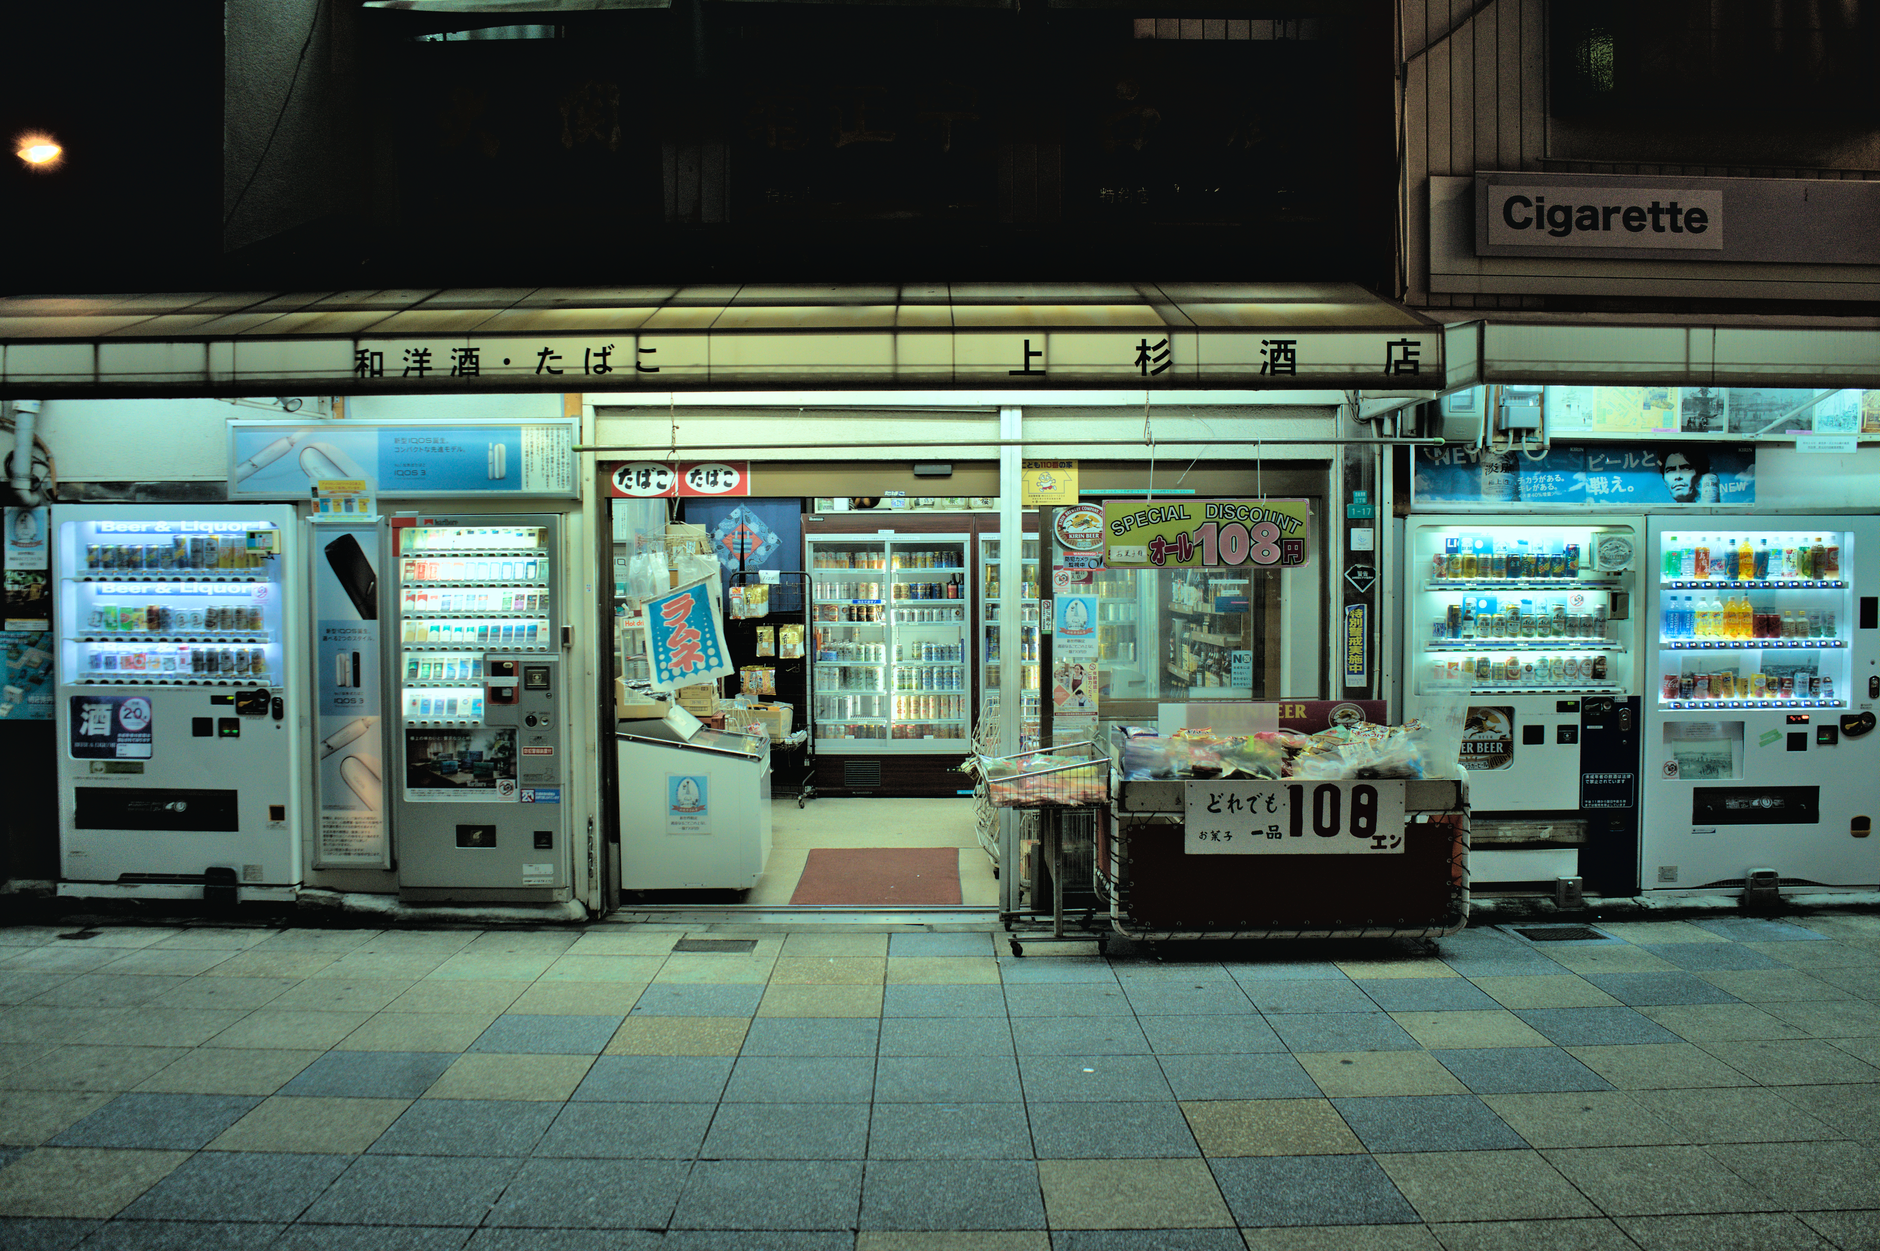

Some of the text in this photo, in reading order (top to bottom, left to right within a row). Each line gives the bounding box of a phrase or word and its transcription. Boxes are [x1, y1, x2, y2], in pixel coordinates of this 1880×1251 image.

[1503, 195, 1708, 237] Cigarette
[354, 343, 660, 378] 和洋酒・たばこ
[1008, 337, 1421, 377] 上杉酒店
[1433, 447, 1486, 466] NEW
[1588, 450, 1663, 472] ビールと、
[617, 467, 668, 489] たばこ
[690, 467, 733, 487] たばこ
[1517, 474, 1565, 484] チカラがある。
[1518, 482, 1558, 492] キレがある。
[1588, 475, 1634, 496] 戦え。
[1719, 481, 1748, 493] NEW
[1110, 503, 1303, 537] SPECIAL DISCOUNT
[1351, 508, 1372, 516] 1-17
[101, 520, 253, 533] Beer & Liquor
[1149, 521, 1305, 566] オール 108 円
[101, 582, 252, 595] Beer & Liquor
[636, 619, 644, 627] dri
[660, 592, 706, 672] ラムネ
[1348, 608, 1363, 674] 特別警戒実施中
[333, 697, 365, 705] IQOS 3
[79, 703, 114, 736] 酒
[1461, 742, 1503, 754] ER BEER
[1206, 783, 1402, 849] どれでも 108 エン
[1198, 825, 1282, 842] お菓子 一品
